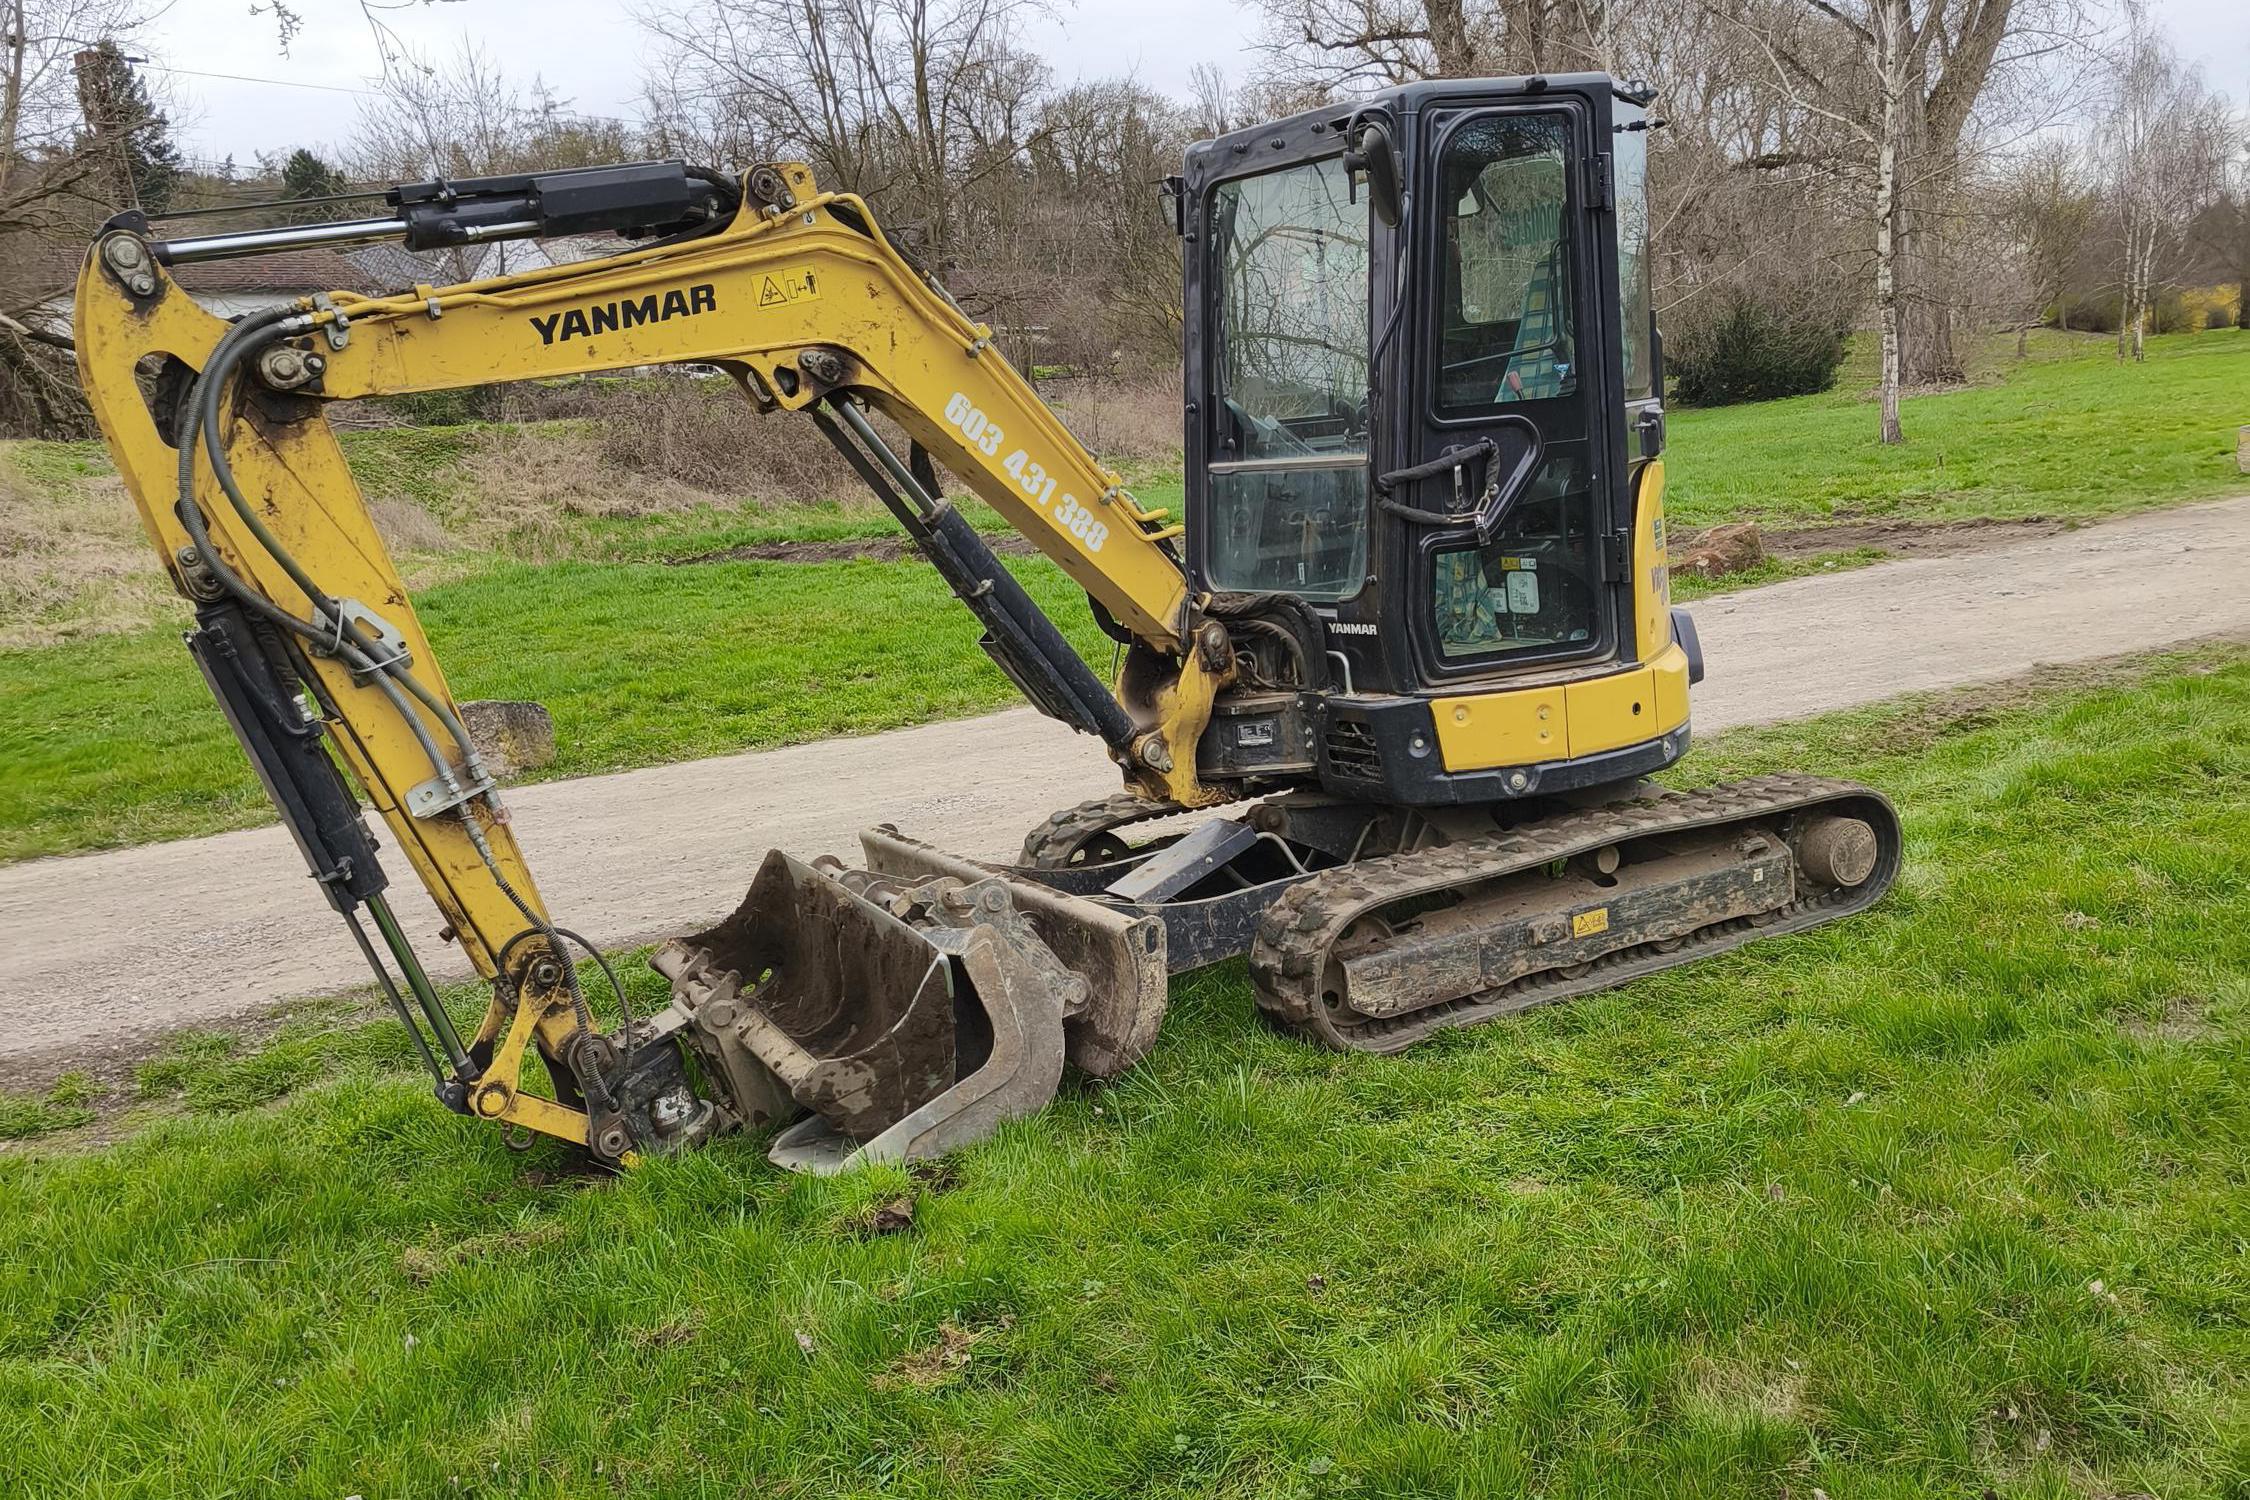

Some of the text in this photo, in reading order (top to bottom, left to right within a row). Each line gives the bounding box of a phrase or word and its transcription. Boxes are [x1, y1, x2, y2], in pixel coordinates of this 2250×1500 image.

[529, 283, 716, 345] YANMAR
[944, 391, 1110, 553] 603 431 388
[1328, 622, 1378, 636] YANMAR
